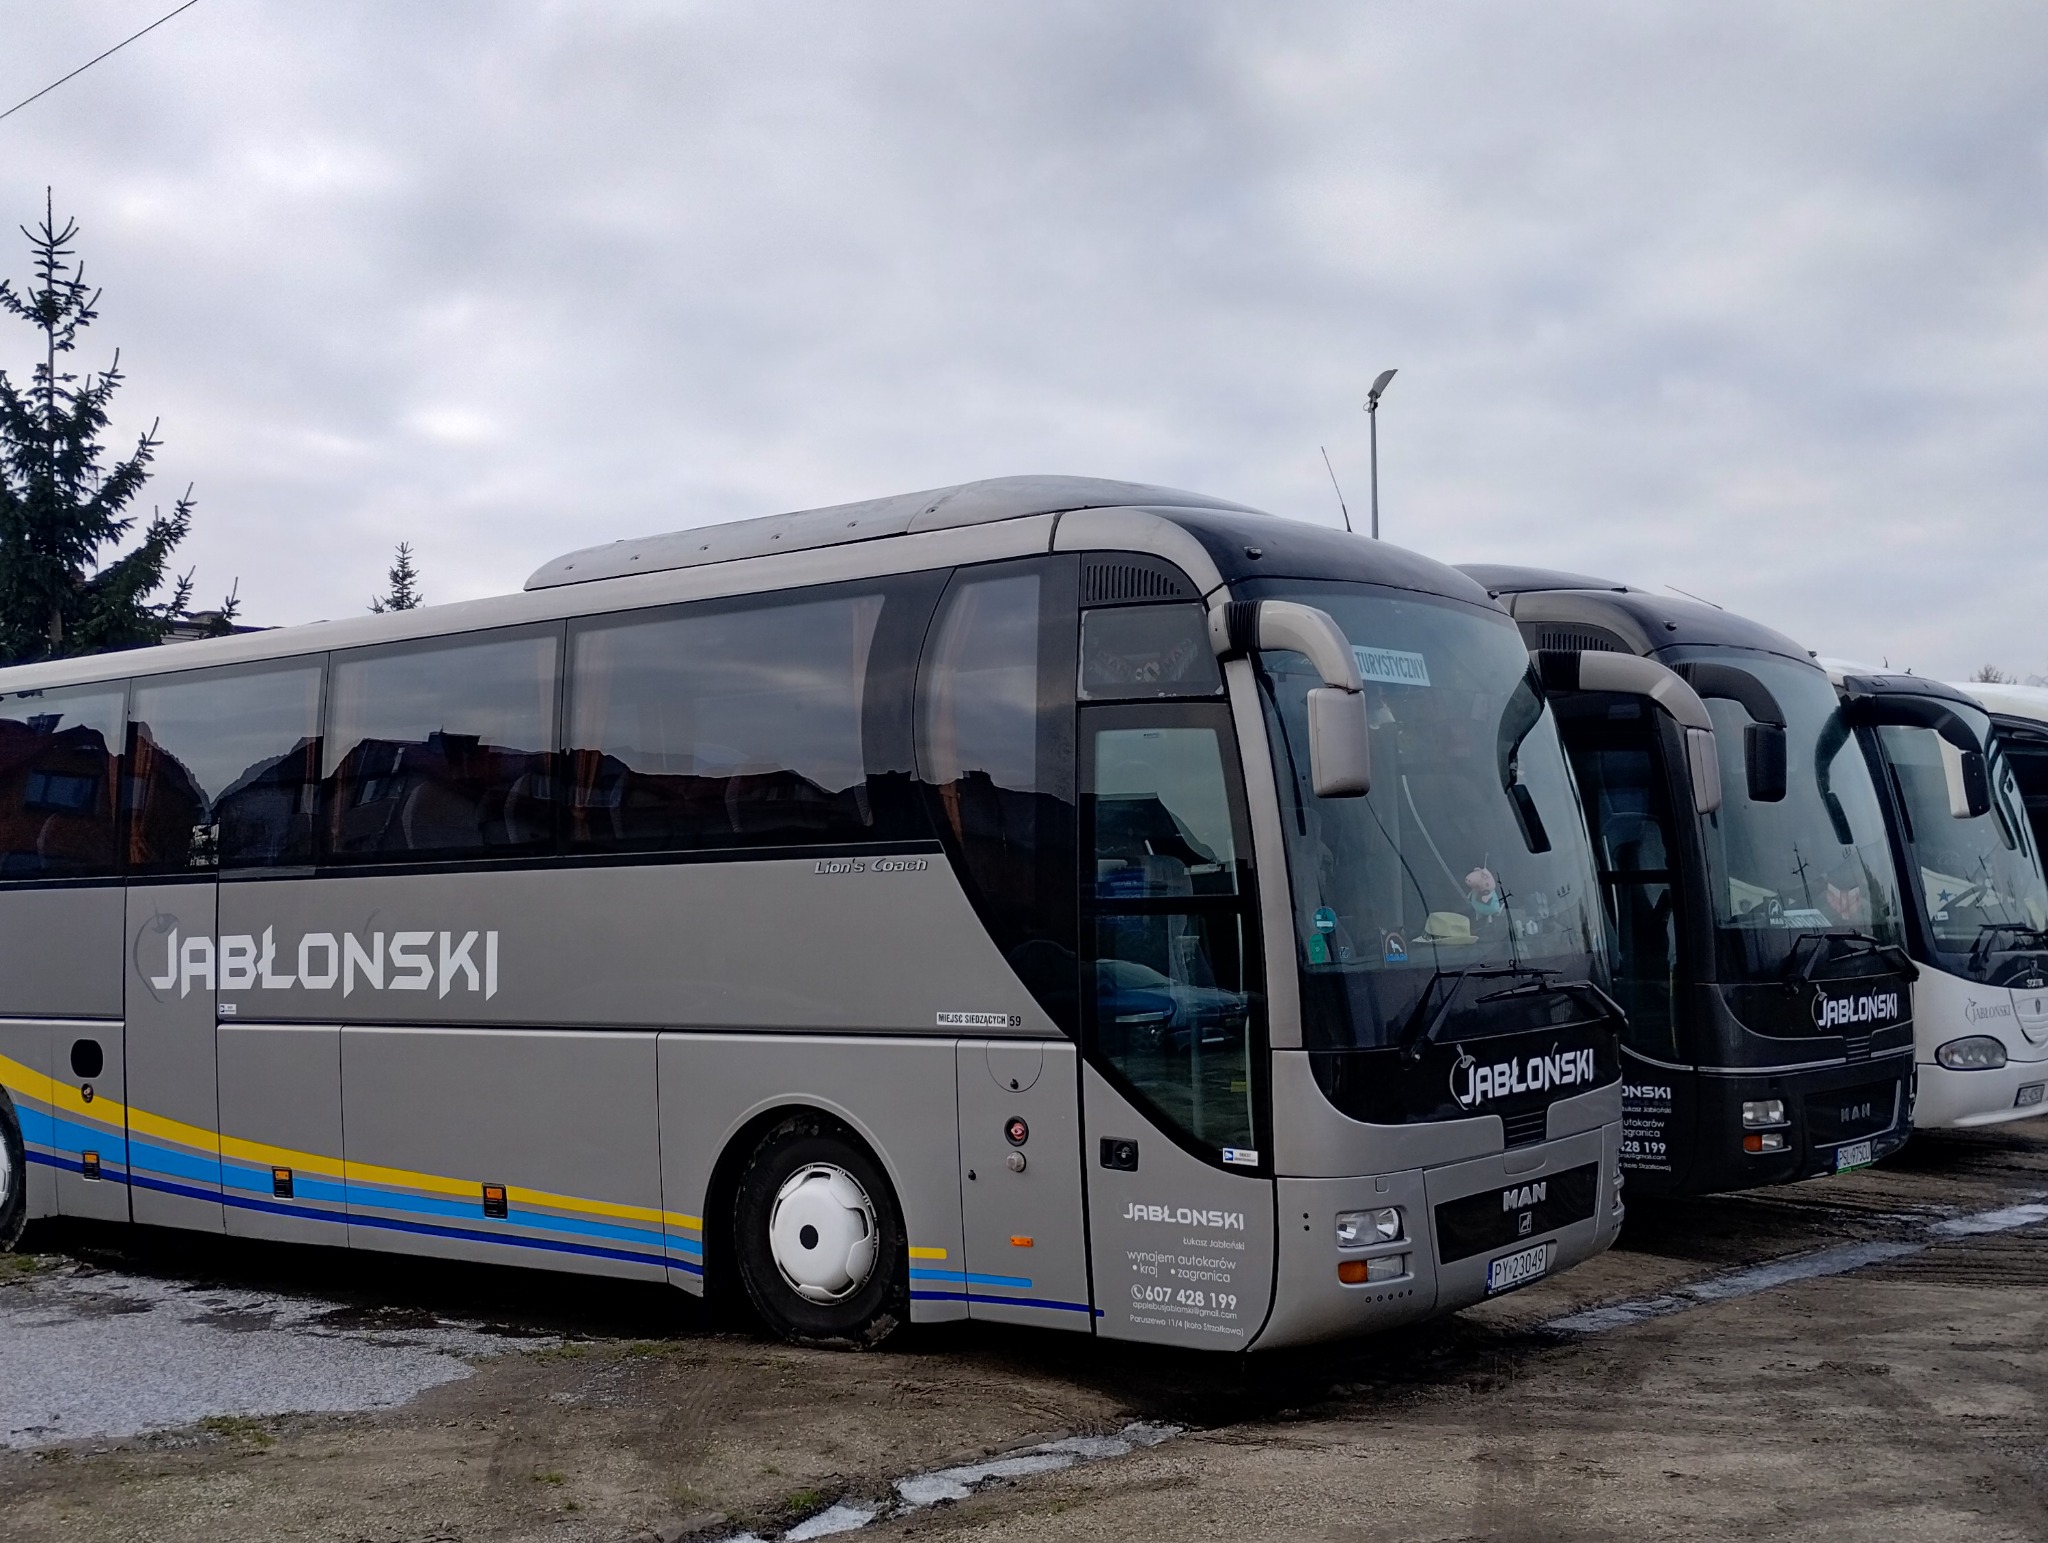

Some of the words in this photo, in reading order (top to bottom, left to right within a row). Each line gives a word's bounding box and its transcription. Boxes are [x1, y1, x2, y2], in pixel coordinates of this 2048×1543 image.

[1355, 651, 1426, 680] TURYSTYCZNY
[814, 857, 865, 874] Lion's
[870, 857, 928, 873] Coach
[938, 1013, 963, 1024] MIEJSC
[1009, 1015, 1022, 1027] 59
[1840, 1102, 1871, 1123] MAN
[1623, 1118, 1665, 1128] utokarów
[1623, 1128, 1660, 1138] agranica
[1643, 1141, 1666, 1154] 199
[1503, 1181, 1547, 1212] MAN
[1126, 1250, 1176, 1265] wynajem
[1177, 1254, 1237, 1270] autokarów
[1494, 1259, 1509, 1286] PY
[1512, 1248, 1544, 1279] 23049
[1140, 1263, 1158, 1278] kraj
[1177, 1268, 1231, 1283] zagranica
[1145, 1285, 1172, 1302] 607
[1176, 1288, 1205, 1307] 428
[1209, 1292, 1237, 1310] 199
